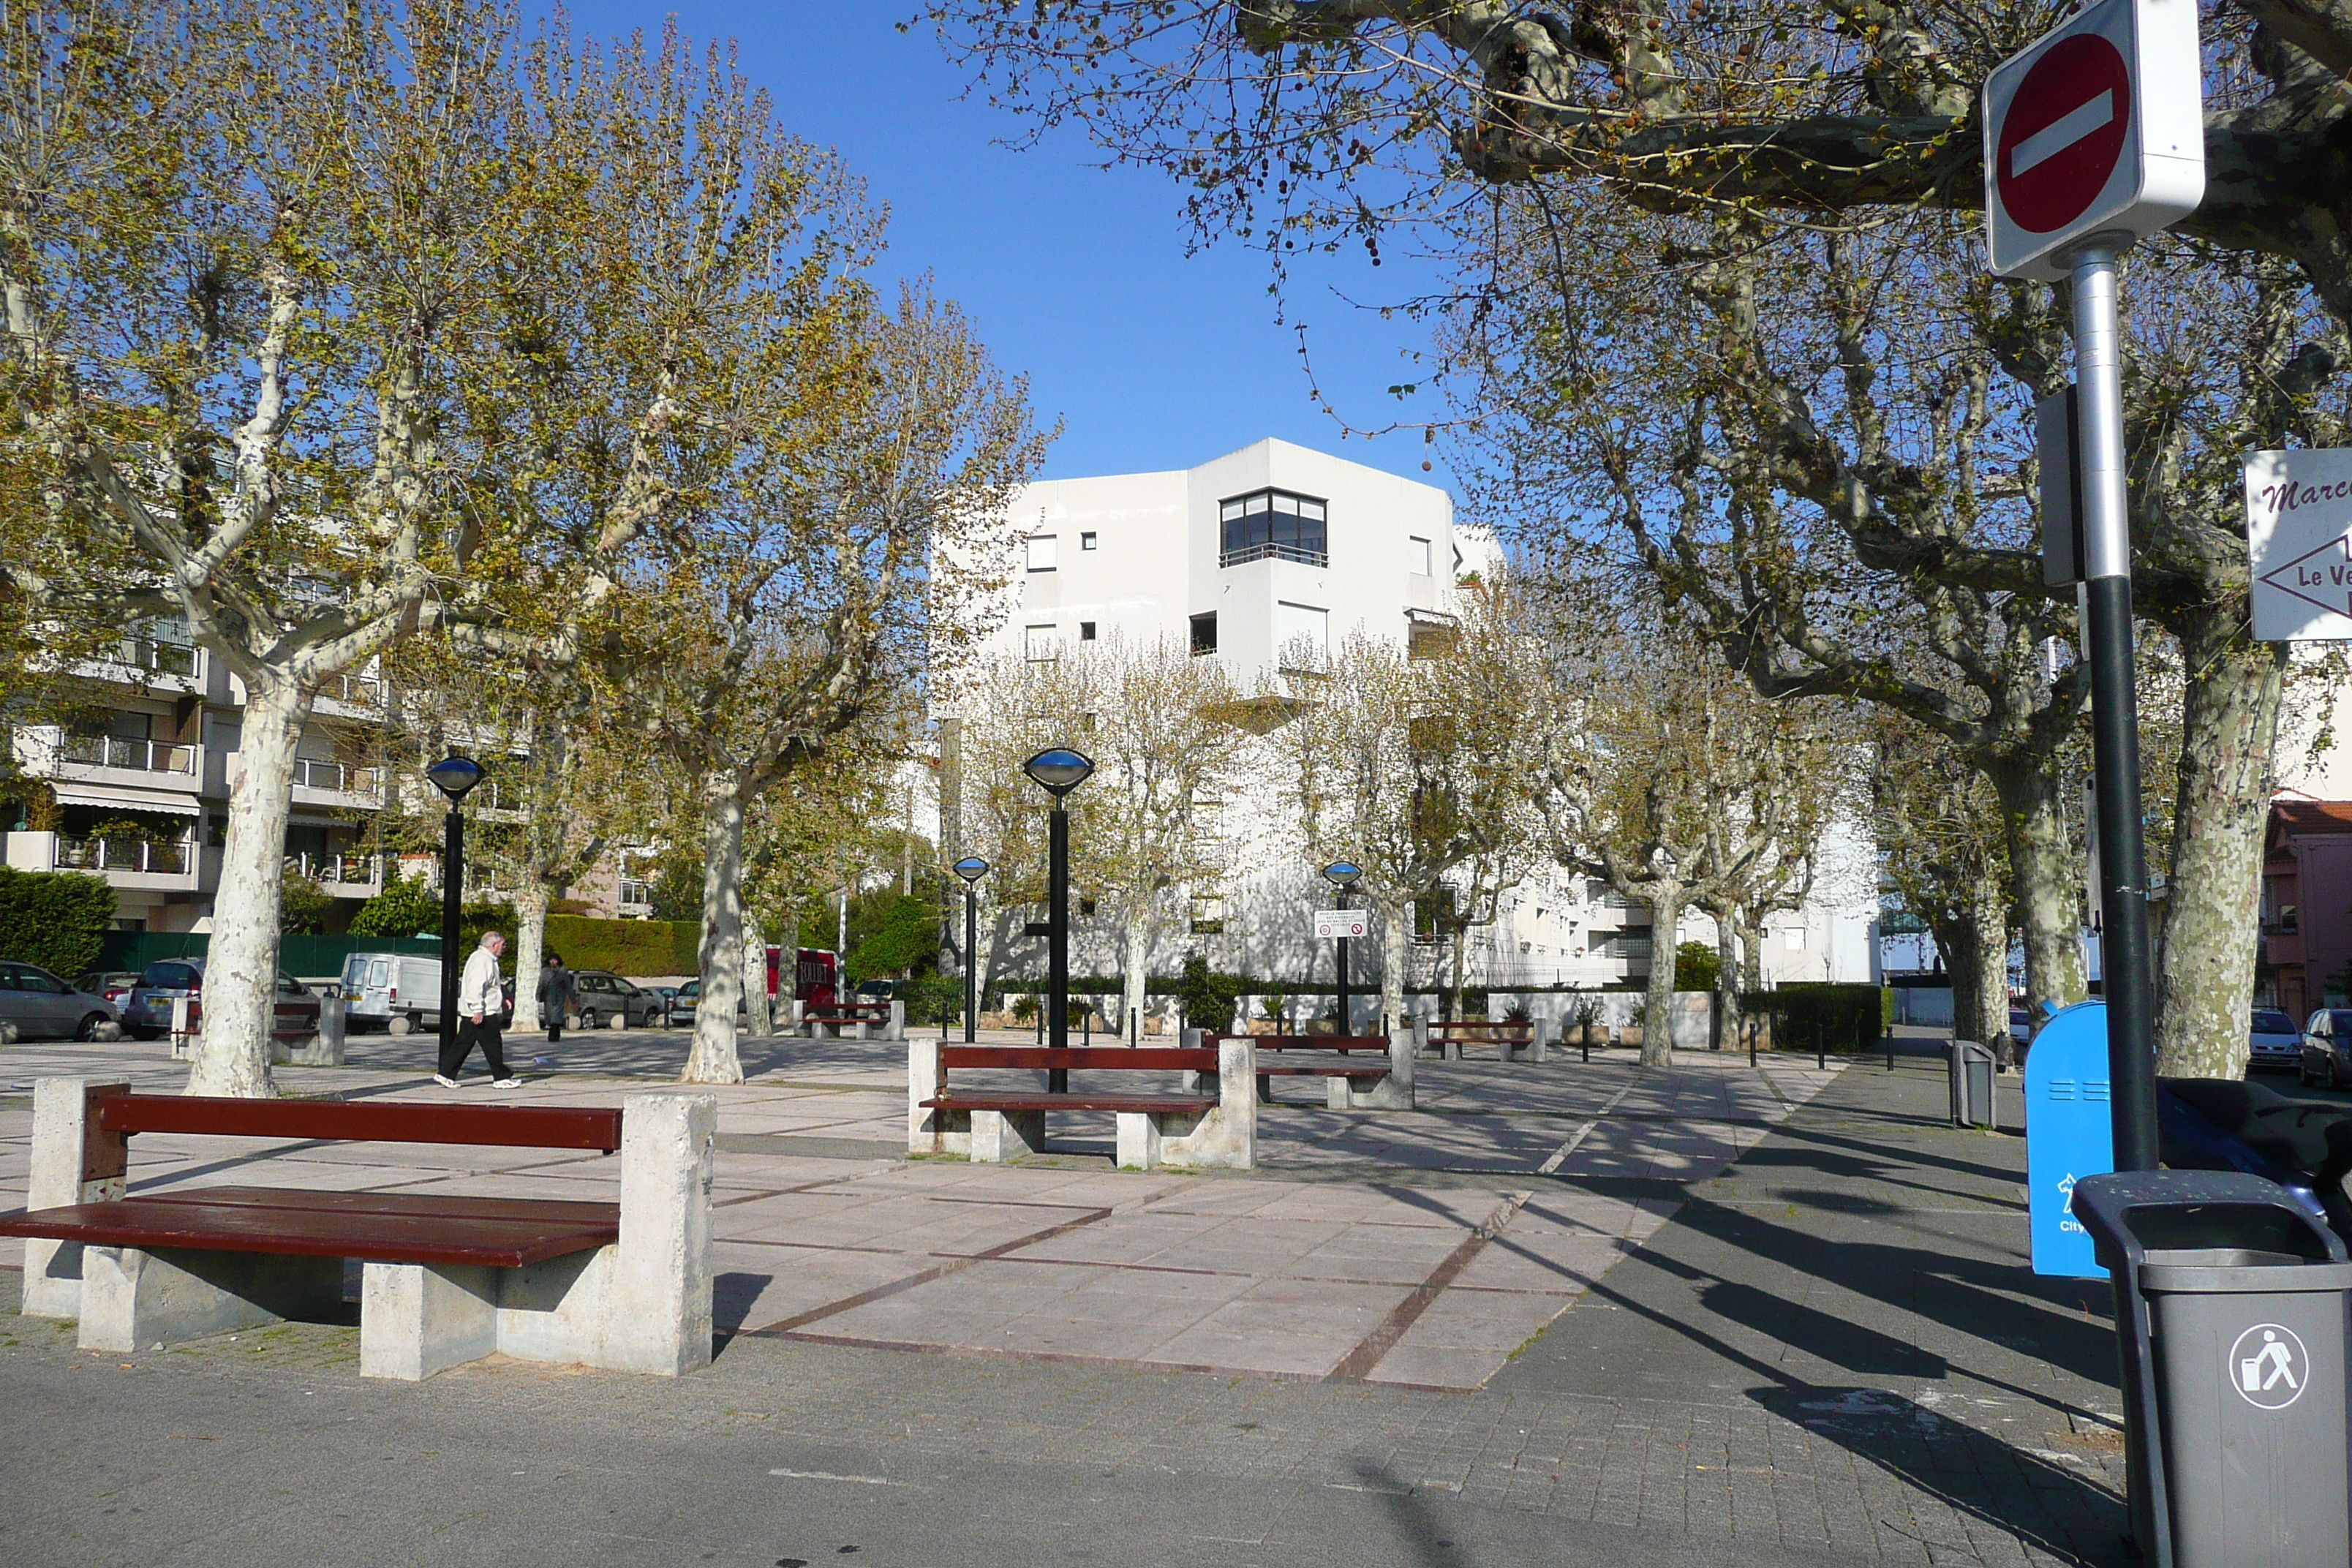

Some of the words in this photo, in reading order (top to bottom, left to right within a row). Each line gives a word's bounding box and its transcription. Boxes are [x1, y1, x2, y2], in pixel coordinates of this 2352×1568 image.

[2262, 480, 2352, 513] Marc
[2298, 566, 2322, 587] Le
[2060, 1221, 2084, 1234] City
